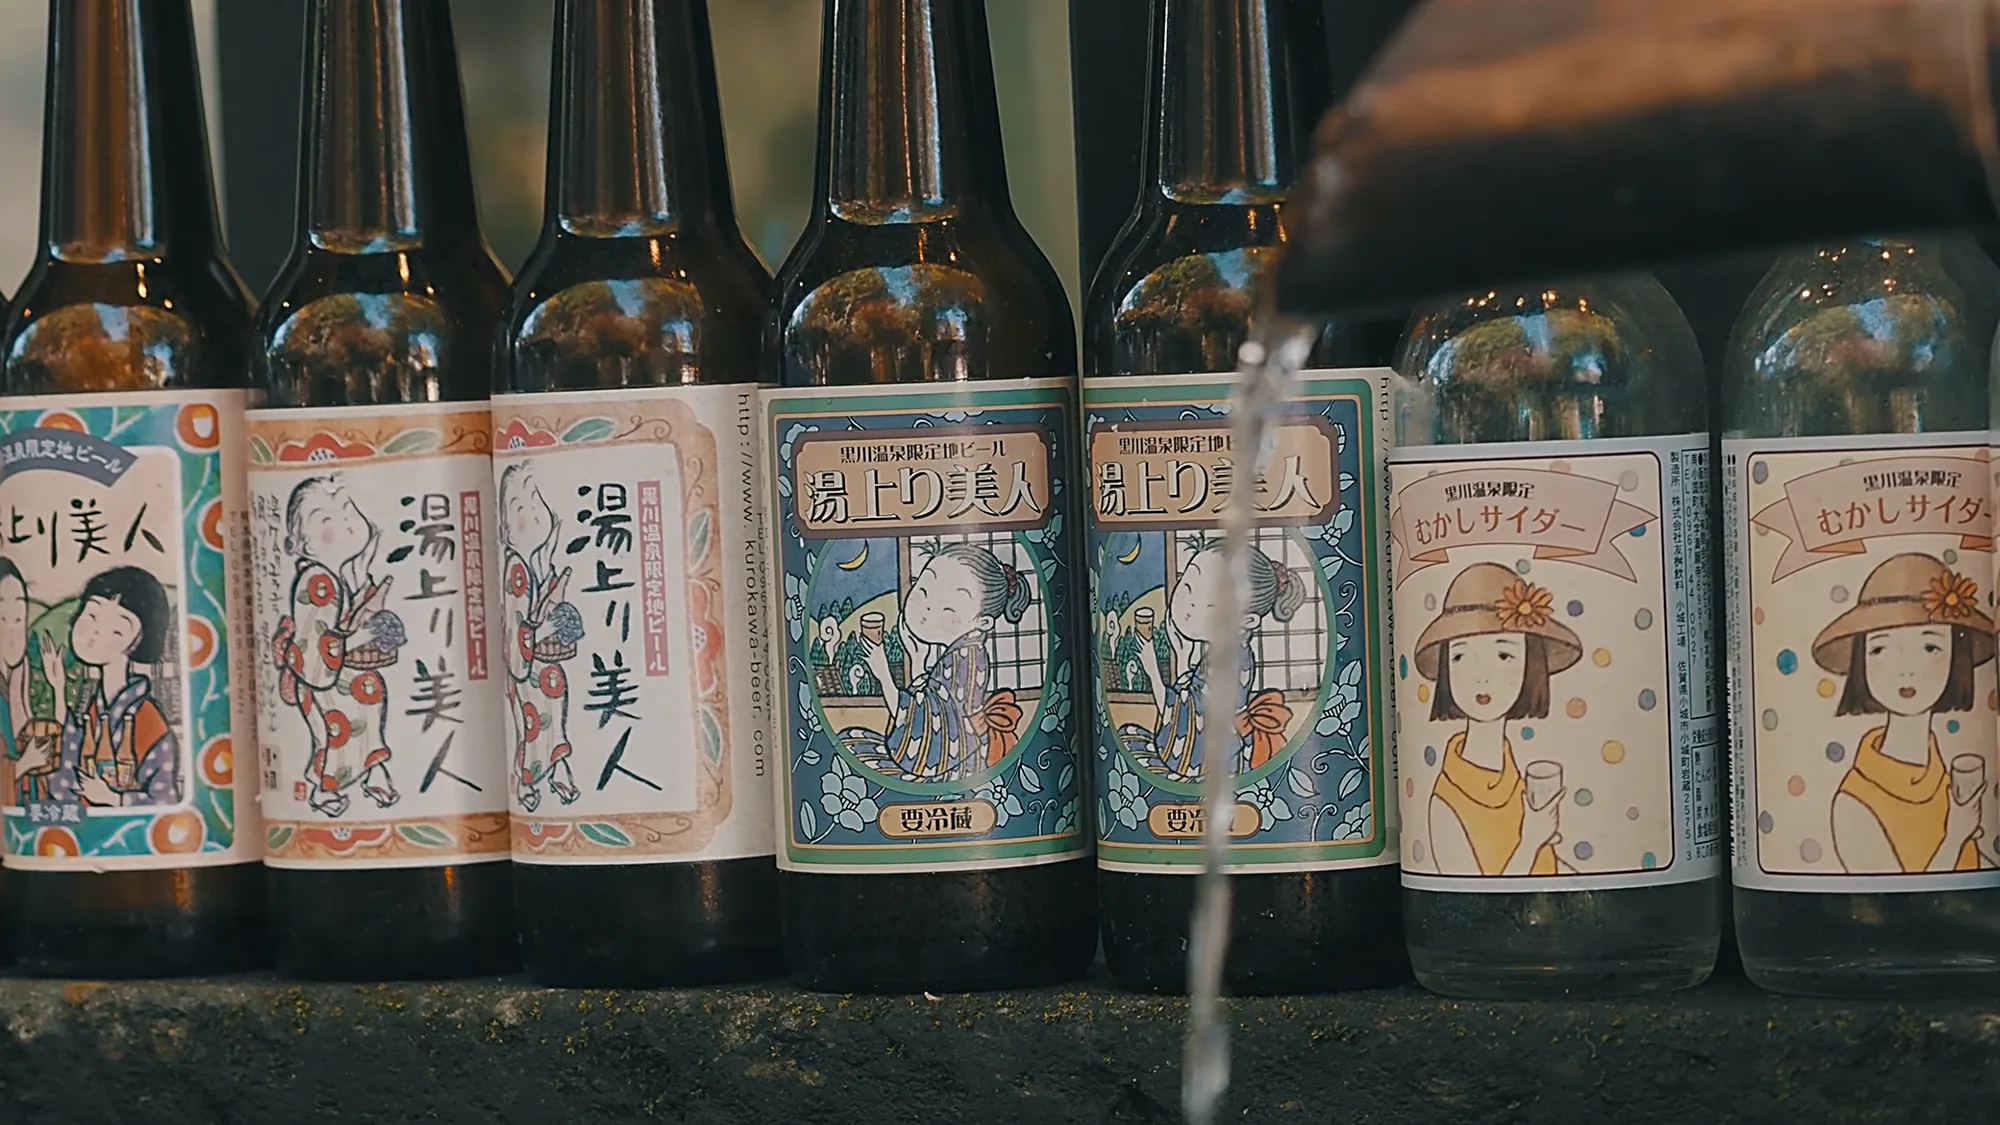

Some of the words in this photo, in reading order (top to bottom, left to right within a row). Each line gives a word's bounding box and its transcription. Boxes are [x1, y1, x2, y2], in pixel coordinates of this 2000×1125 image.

[840, 441, 1007, 464] 黒川温泉限定地ビール
[804, 460, 1043, 525] 湯上り美人
[1445, 481, 1535, 501] 黒川温泉限定
[1863, 470, 1962, 492] 黒川温泉限定
[0, 499, 165, 568] 上り美人
[1414, 505, 1586, 546] むかしサイダー
[641, 485, 666, 672] 黒川温泉限定地ビール
[386, 493, 482, 793] 湯上り美人
[566, 483, 662, 791] 湯上り美人
[900, 807, 973, 832] 要冷蔵
[1167, 808, 1234, 833] 要冷
